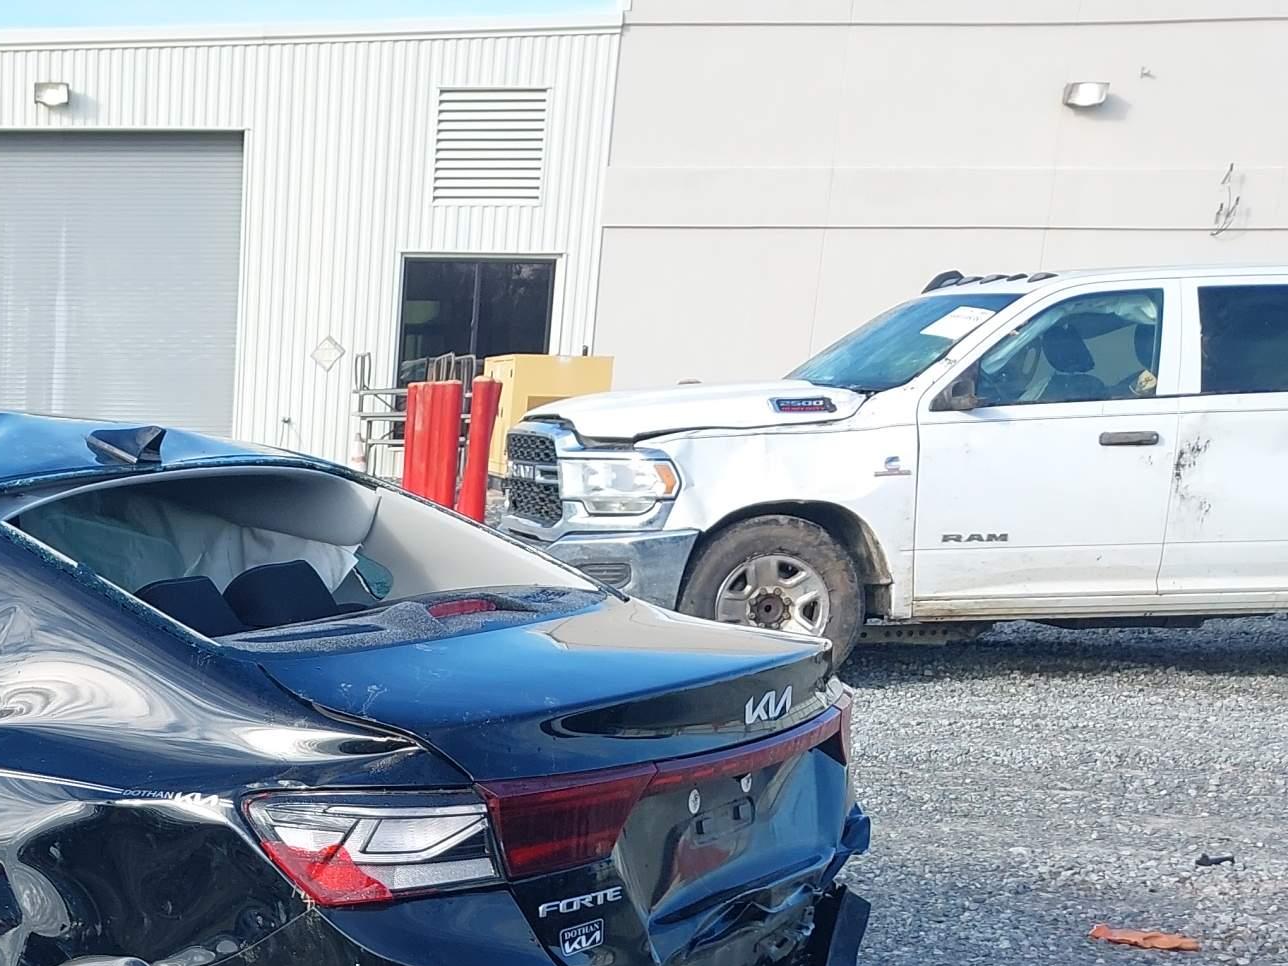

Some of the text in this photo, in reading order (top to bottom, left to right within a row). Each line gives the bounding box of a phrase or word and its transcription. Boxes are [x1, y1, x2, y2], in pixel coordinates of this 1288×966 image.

[941, 533, 1009, 543] RAM
[745, 685, 793, 725] KIA
[122, 789, 174, 800] DOTHAN
[538, 886, 623, 918] FORTE
[564, 922, 600, 940] DOTHAN
[564, 930, 601, 954] KIA
